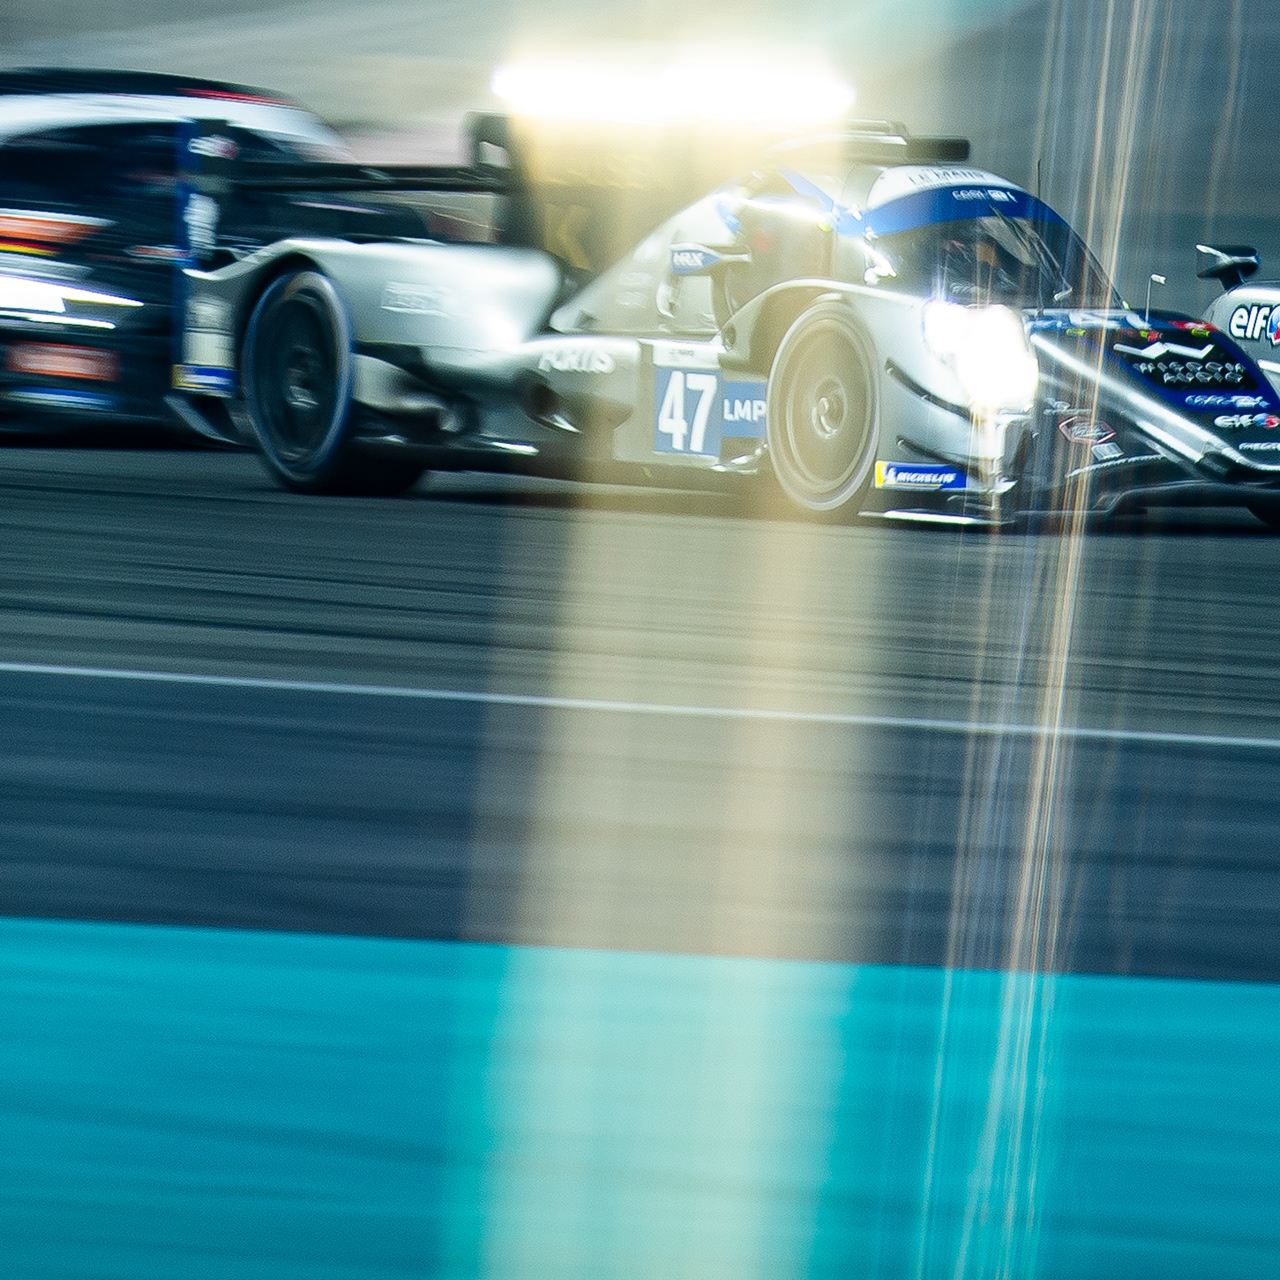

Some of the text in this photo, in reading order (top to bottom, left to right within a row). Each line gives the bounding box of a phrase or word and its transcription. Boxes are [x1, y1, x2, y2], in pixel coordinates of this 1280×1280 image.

[1229, 305, 1271, 340] elf
[657, 370, 718, 452] 47
[896, 471, 958, 484] MICHELIN
